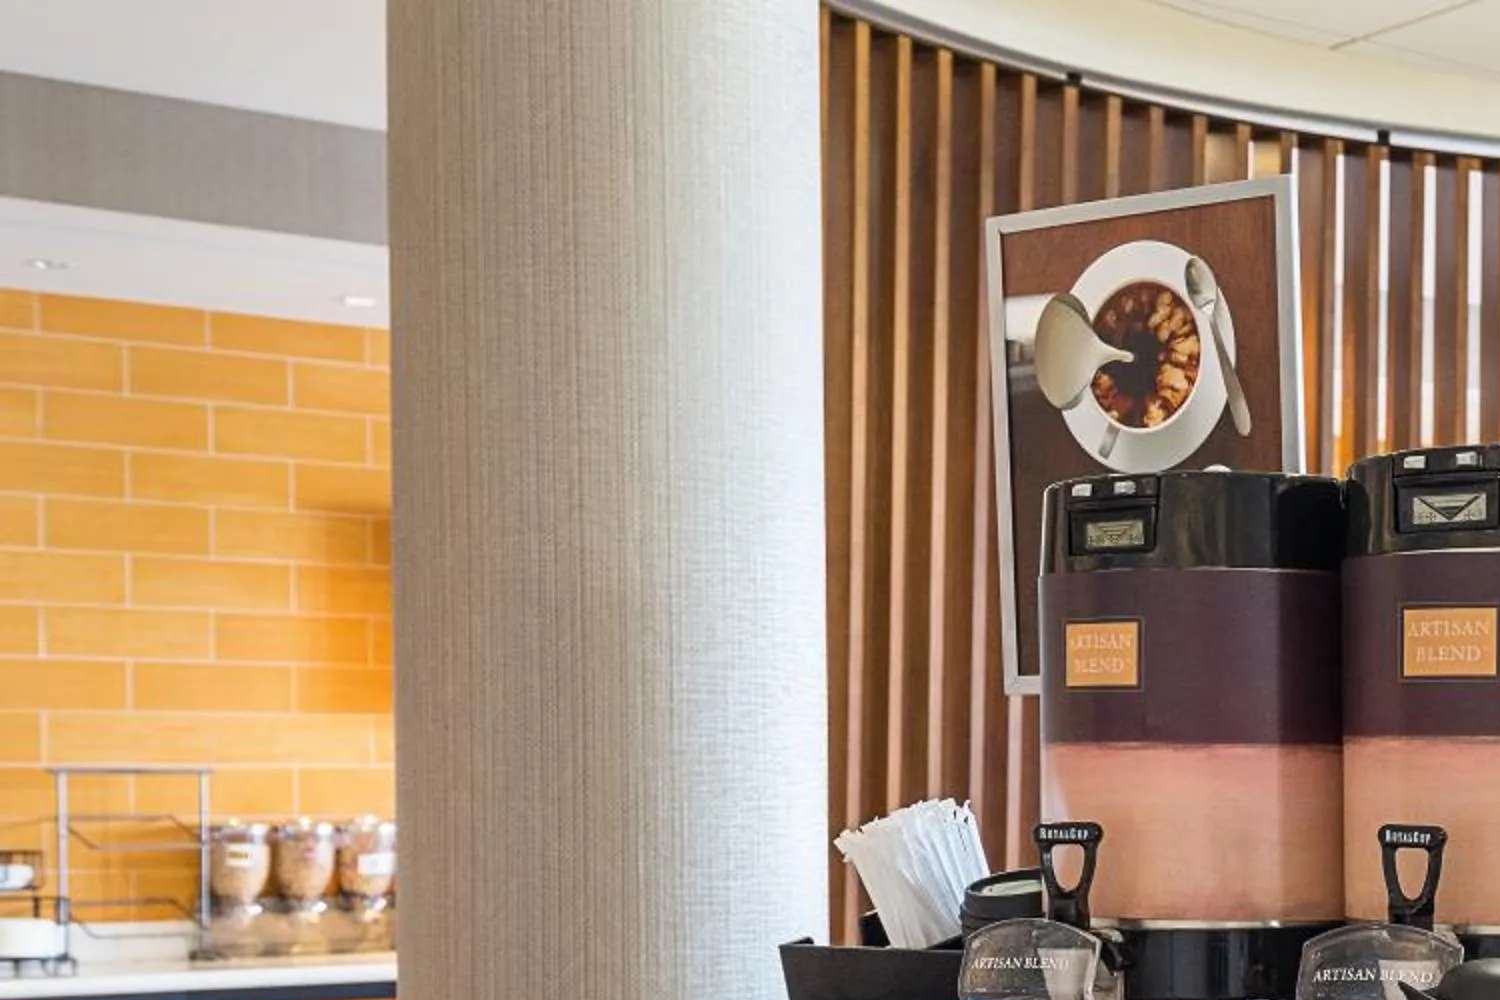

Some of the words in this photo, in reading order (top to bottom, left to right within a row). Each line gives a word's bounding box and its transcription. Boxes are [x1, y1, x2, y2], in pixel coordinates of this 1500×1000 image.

[1406, 618, 1490, 637] ARTISAN
[1070, 632, 1132, 650] ARTISAN
[1416, 644, 1482, 663] BLEND
[1074, 657, 1125, 674] BLEND
[971, 956, 1022, 970] ARTISAN
[1023, 956, 1069, 969] BLEND
[1312, 966, 1378, 982] ARTISAN
[1380, 968, 1434, 983] BLEND
